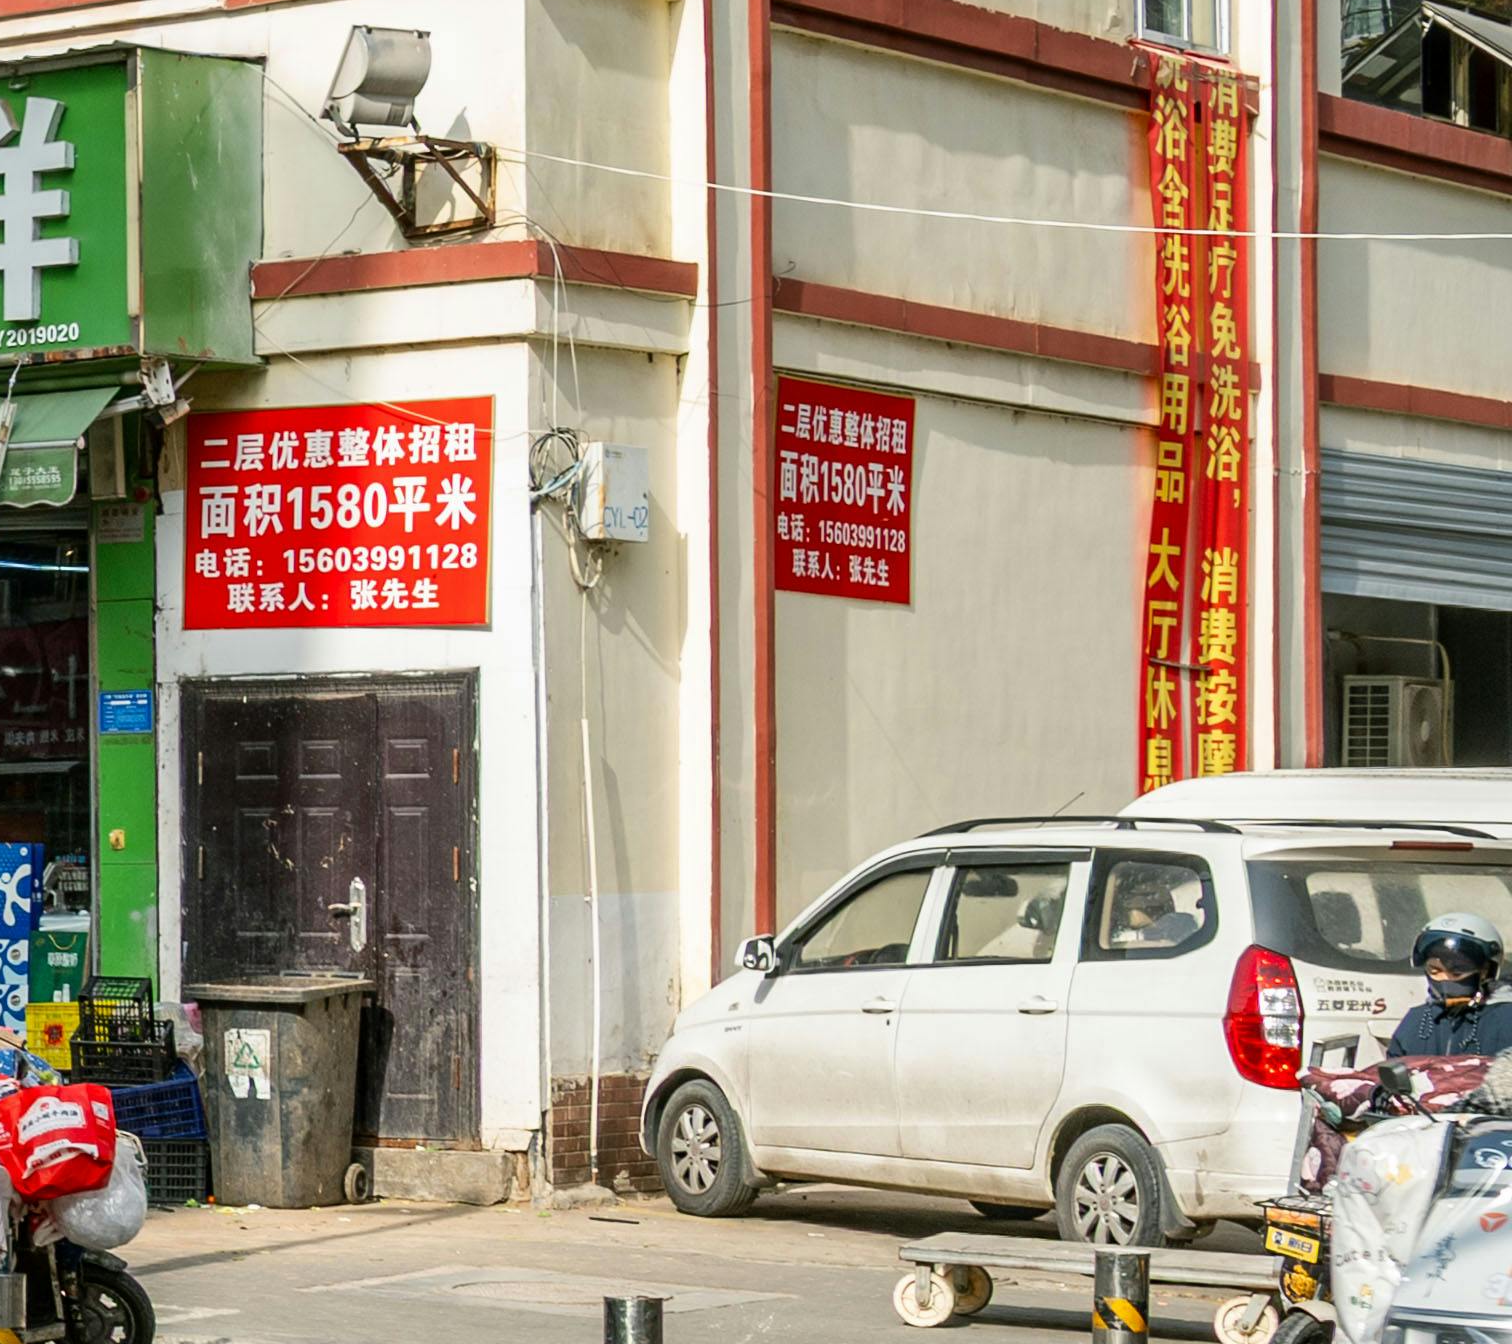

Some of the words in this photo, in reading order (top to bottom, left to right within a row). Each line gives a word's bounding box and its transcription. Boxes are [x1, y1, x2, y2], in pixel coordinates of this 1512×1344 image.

[200, 422, 477, 473] 二层优惠整体招租
[781, 403, 907, 454] 二层优惠整体招租
[199, 472, 477, 539] 面积1580平米
[780, 450, 906, 517] 面积1580平米
[281, 542, 478, 575] 15603991128
[818, 519, 906, 553] 15603991128
[350, 576, 440, 610] 张先生
[849, 555, 890, 587] 张先生
[1196, 547, 1239, 778] 消费按摩
